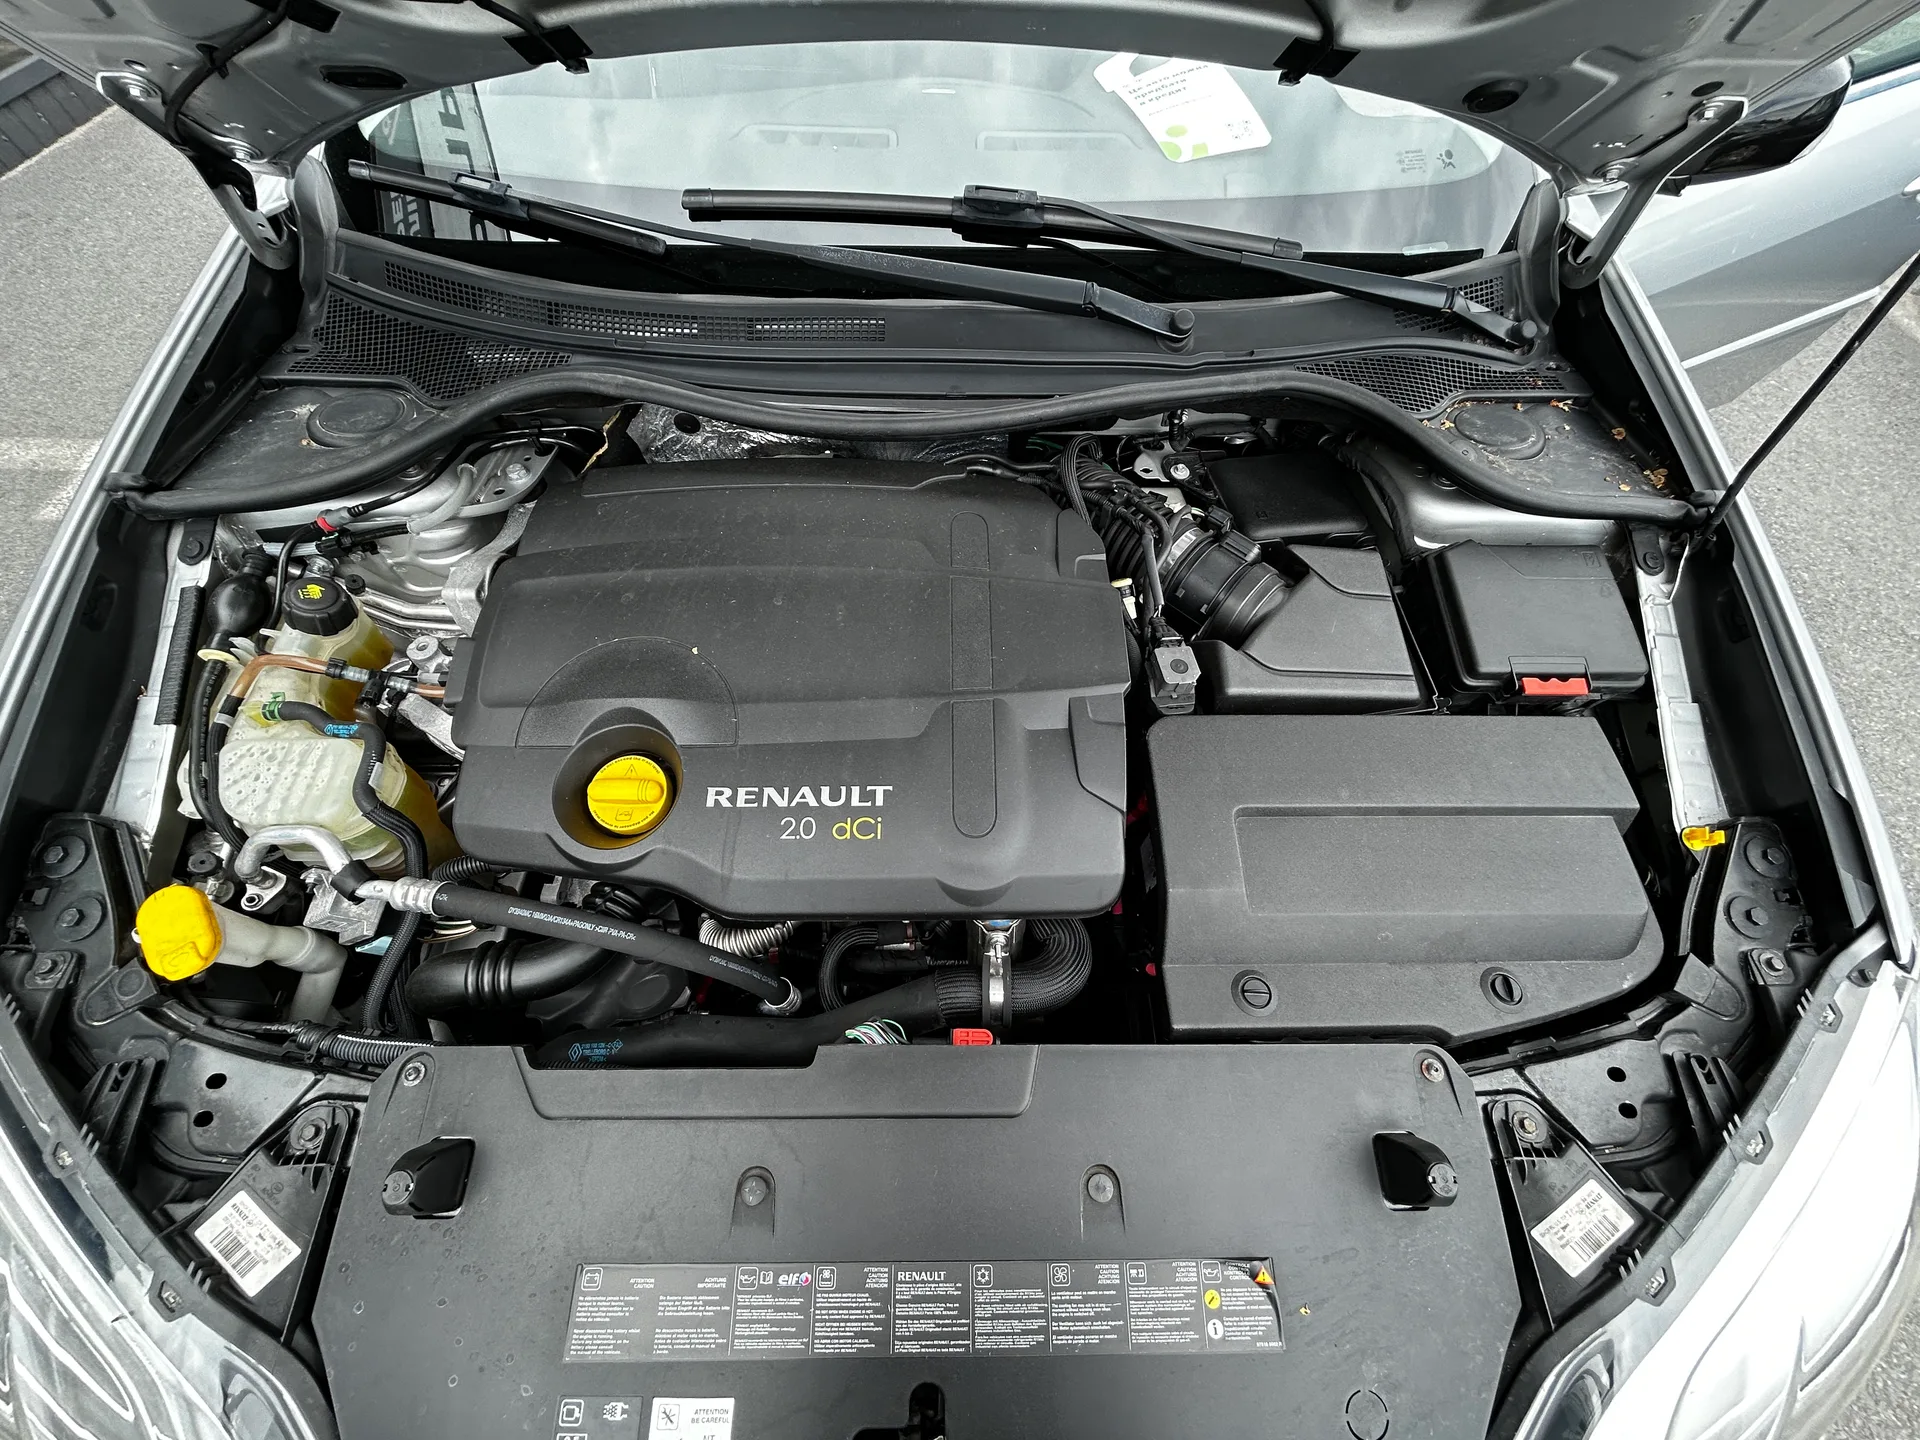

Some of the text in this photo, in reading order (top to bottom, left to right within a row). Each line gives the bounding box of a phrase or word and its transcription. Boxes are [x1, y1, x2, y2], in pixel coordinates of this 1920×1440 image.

[706, 786, 893, 808] RENAULT
[780, 816, 882, 840] 2.0 dCi
[778, 1272, 800, 1285] elf
[898, 1271, 946, 1281] RENAULT
